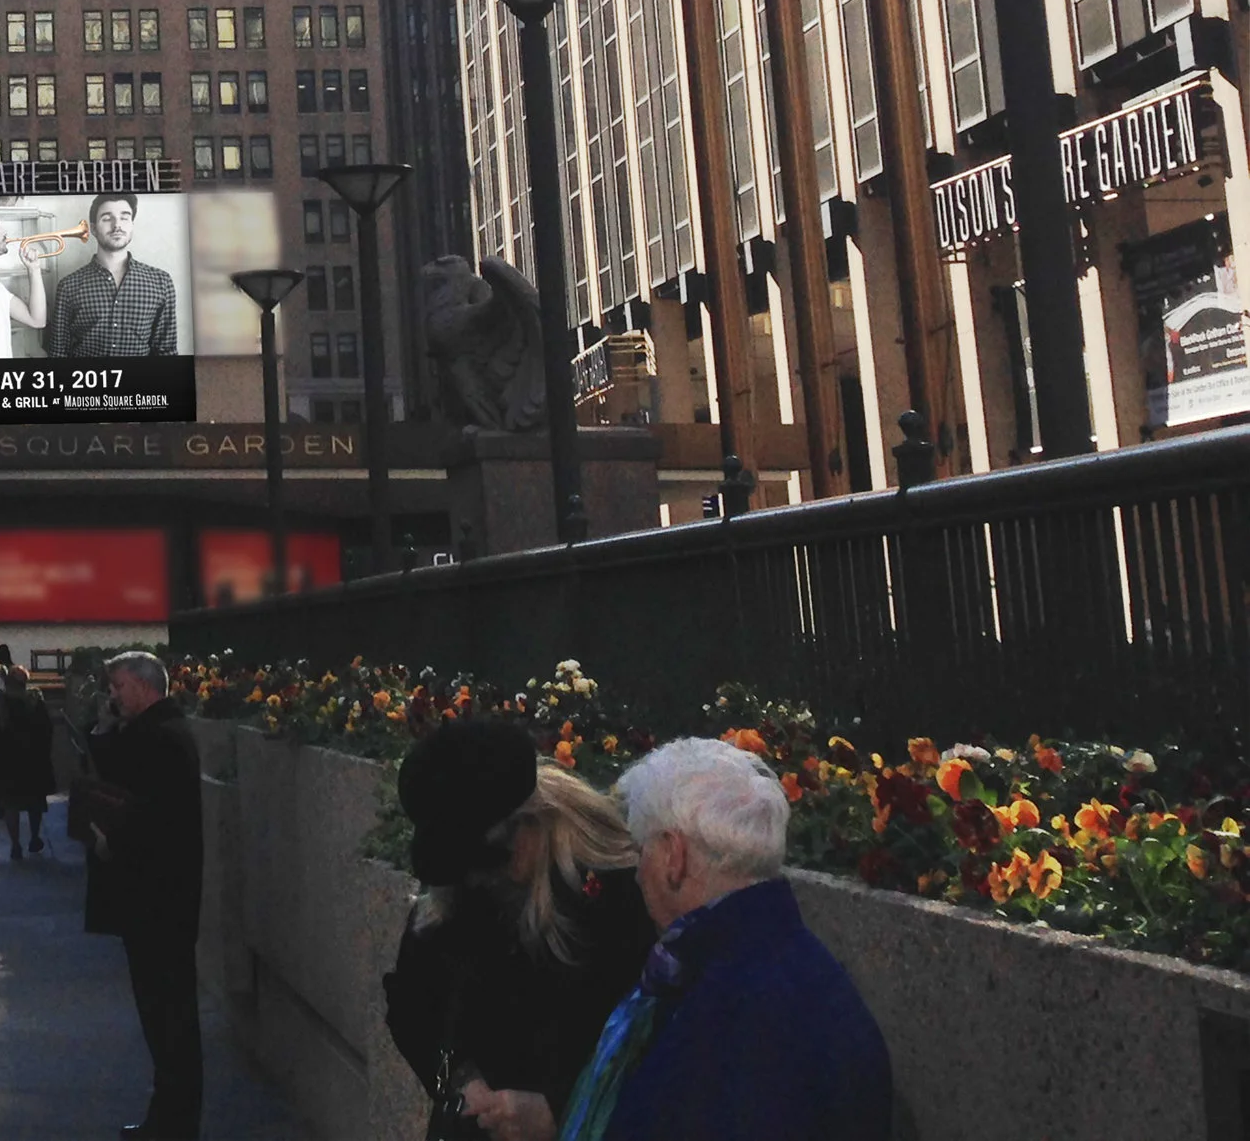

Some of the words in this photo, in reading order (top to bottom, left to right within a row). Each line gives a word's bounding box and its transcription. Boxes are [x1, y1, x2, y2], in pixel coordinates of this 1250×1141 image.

[1095, 92, 1197, 192] GARDEN
[58, 159, 161, 192] GARDEN
[32, 371, 64, 392] 31,
[71, 369, 123, 388] 2017
[2, 397, 12, 408] &
[15, 396, 48, 408] GRILL
[52, 397, 61, 405] AT
[64, 395, 100, 407] MADISON
[103, 394, 133, 407] SQUARE
[0, 435, 161, 455] SQUARE
